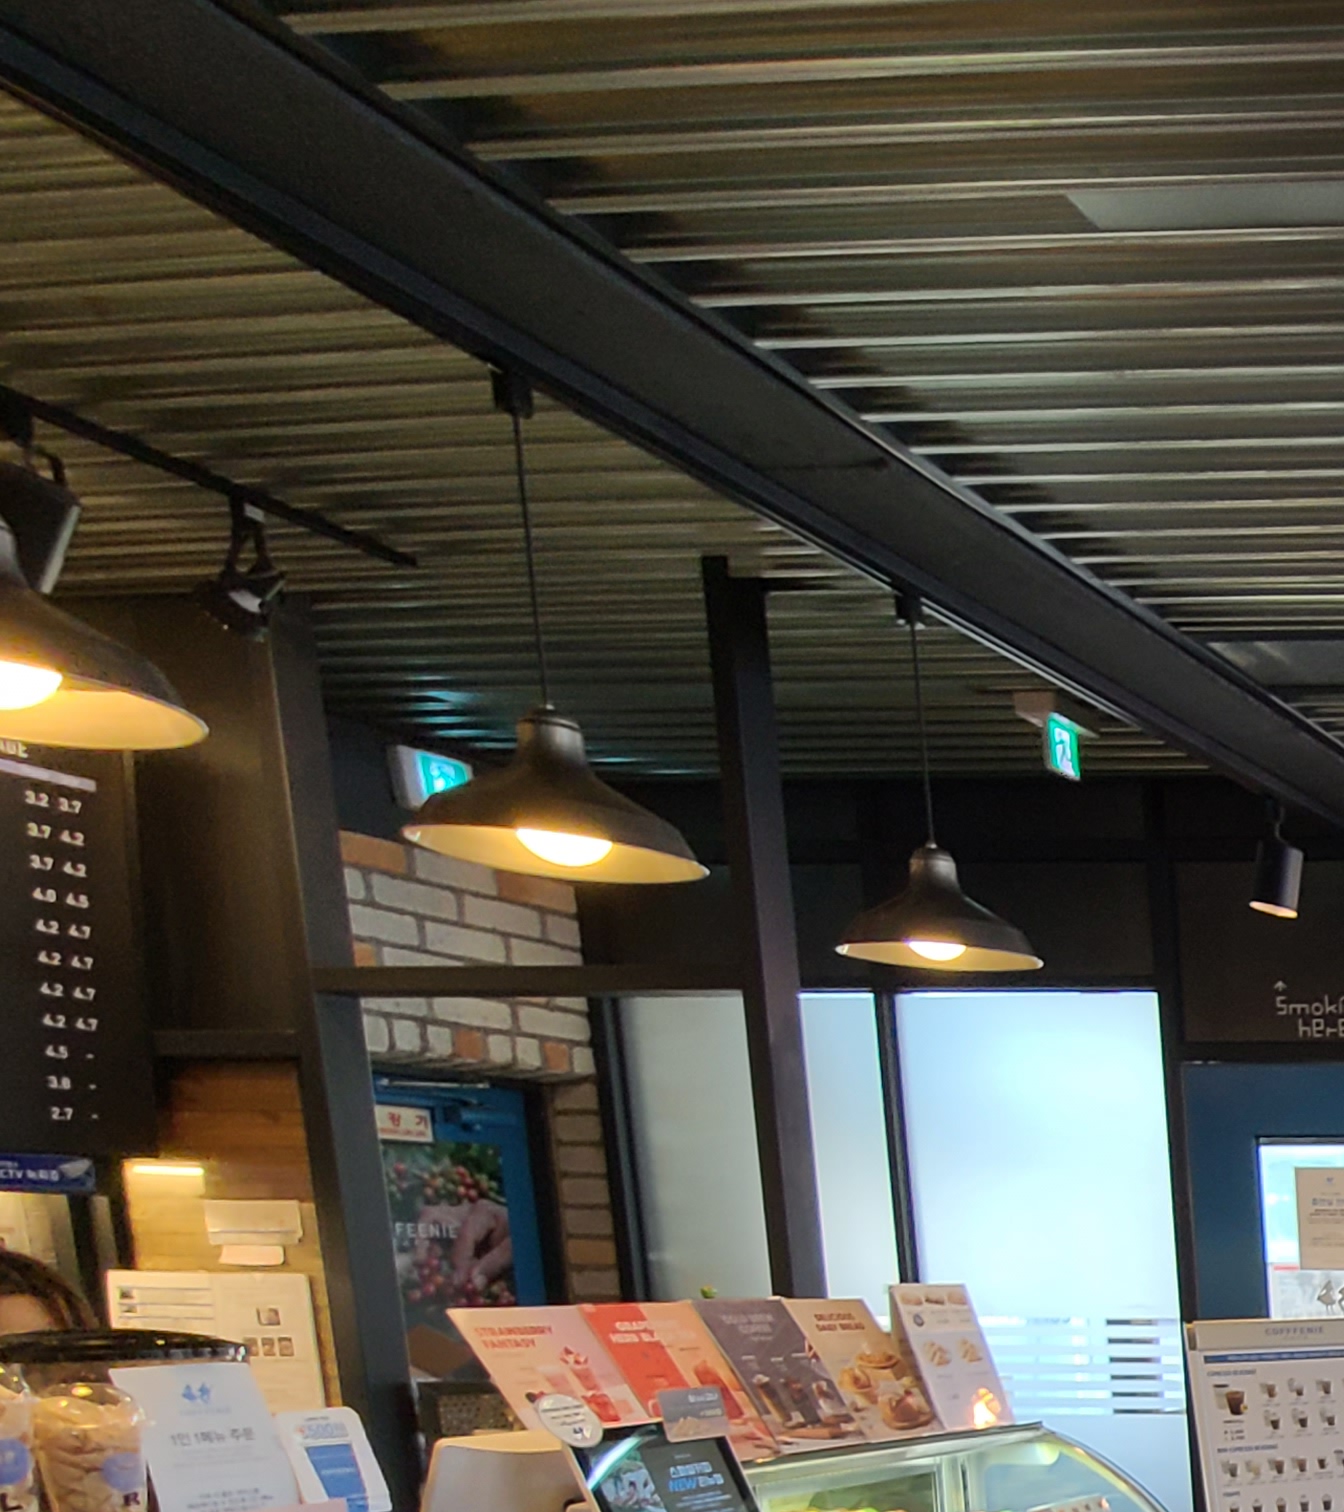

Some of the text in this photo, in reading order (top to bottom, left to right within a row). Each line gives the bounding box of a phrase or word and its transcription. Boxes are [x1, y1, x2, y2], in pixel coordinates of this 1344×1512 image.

[35, 919, 92, 939] 4.2 4.7
[37, 951, 94, 970] 4.2 4.7
[40, 982, 96, 1001] 4.2 4.7
[42, 1014, 98, 1032] 4.2 4.7
[45, 1045, 69, 1059] 4.5
[51, 1107, 74, 1121] 2.7
